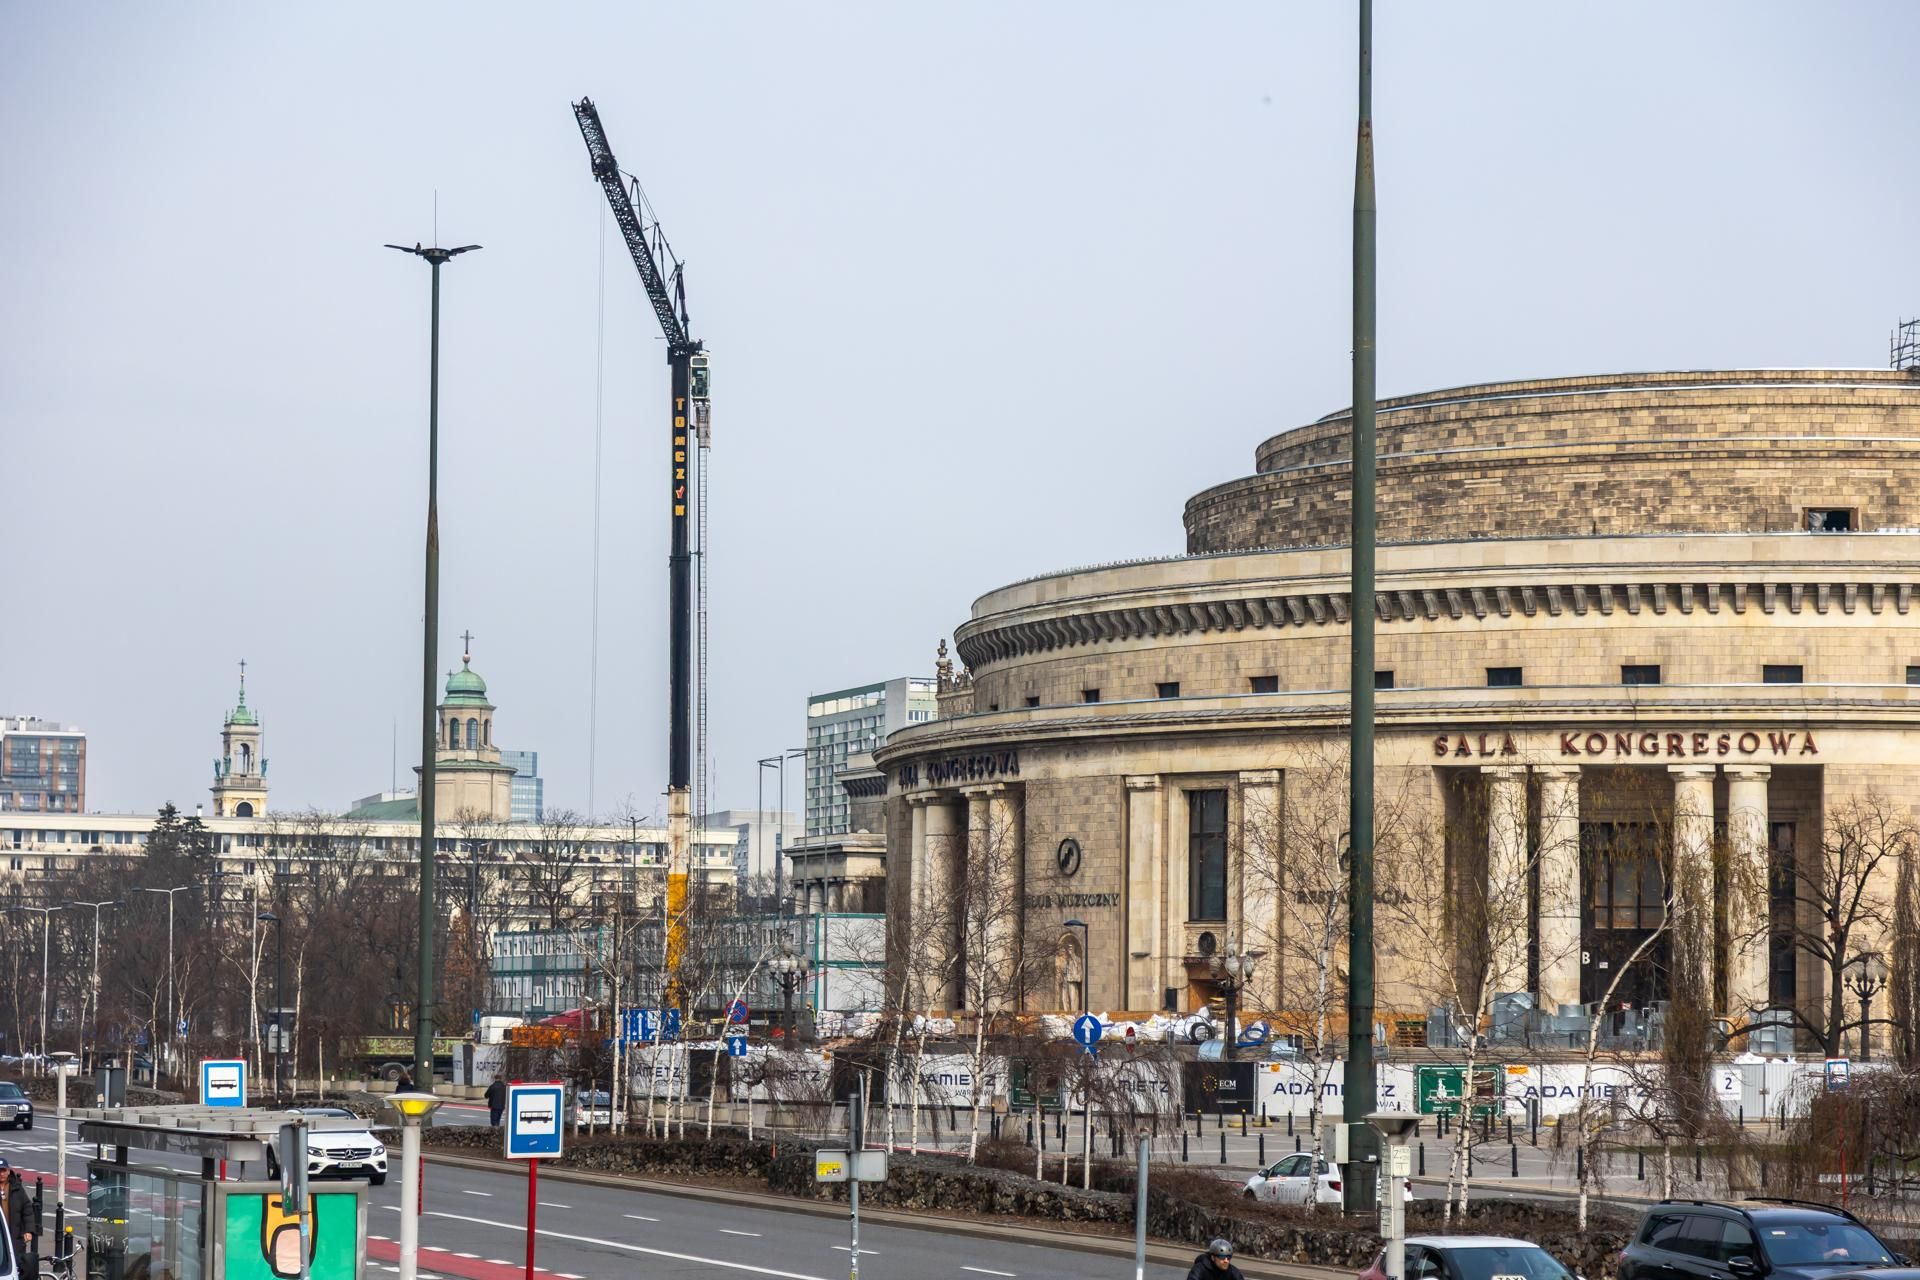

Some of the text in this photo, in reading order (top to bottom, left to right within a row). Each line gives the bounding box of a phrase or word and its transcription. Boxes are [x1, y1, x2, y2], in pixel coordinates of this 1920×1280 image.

[1434, 732, 1819, 757] SALA KONGRESOWA
[1057, 893, 1120, 908] MUZYCZNY
[1582, 951, 1591, 965] B
[1219, 1080, 1237, 1088] ECM
[1273, 1082, 1396, 1097] ADAMIZ
[1725, 1077, 1733, 1090] 2
